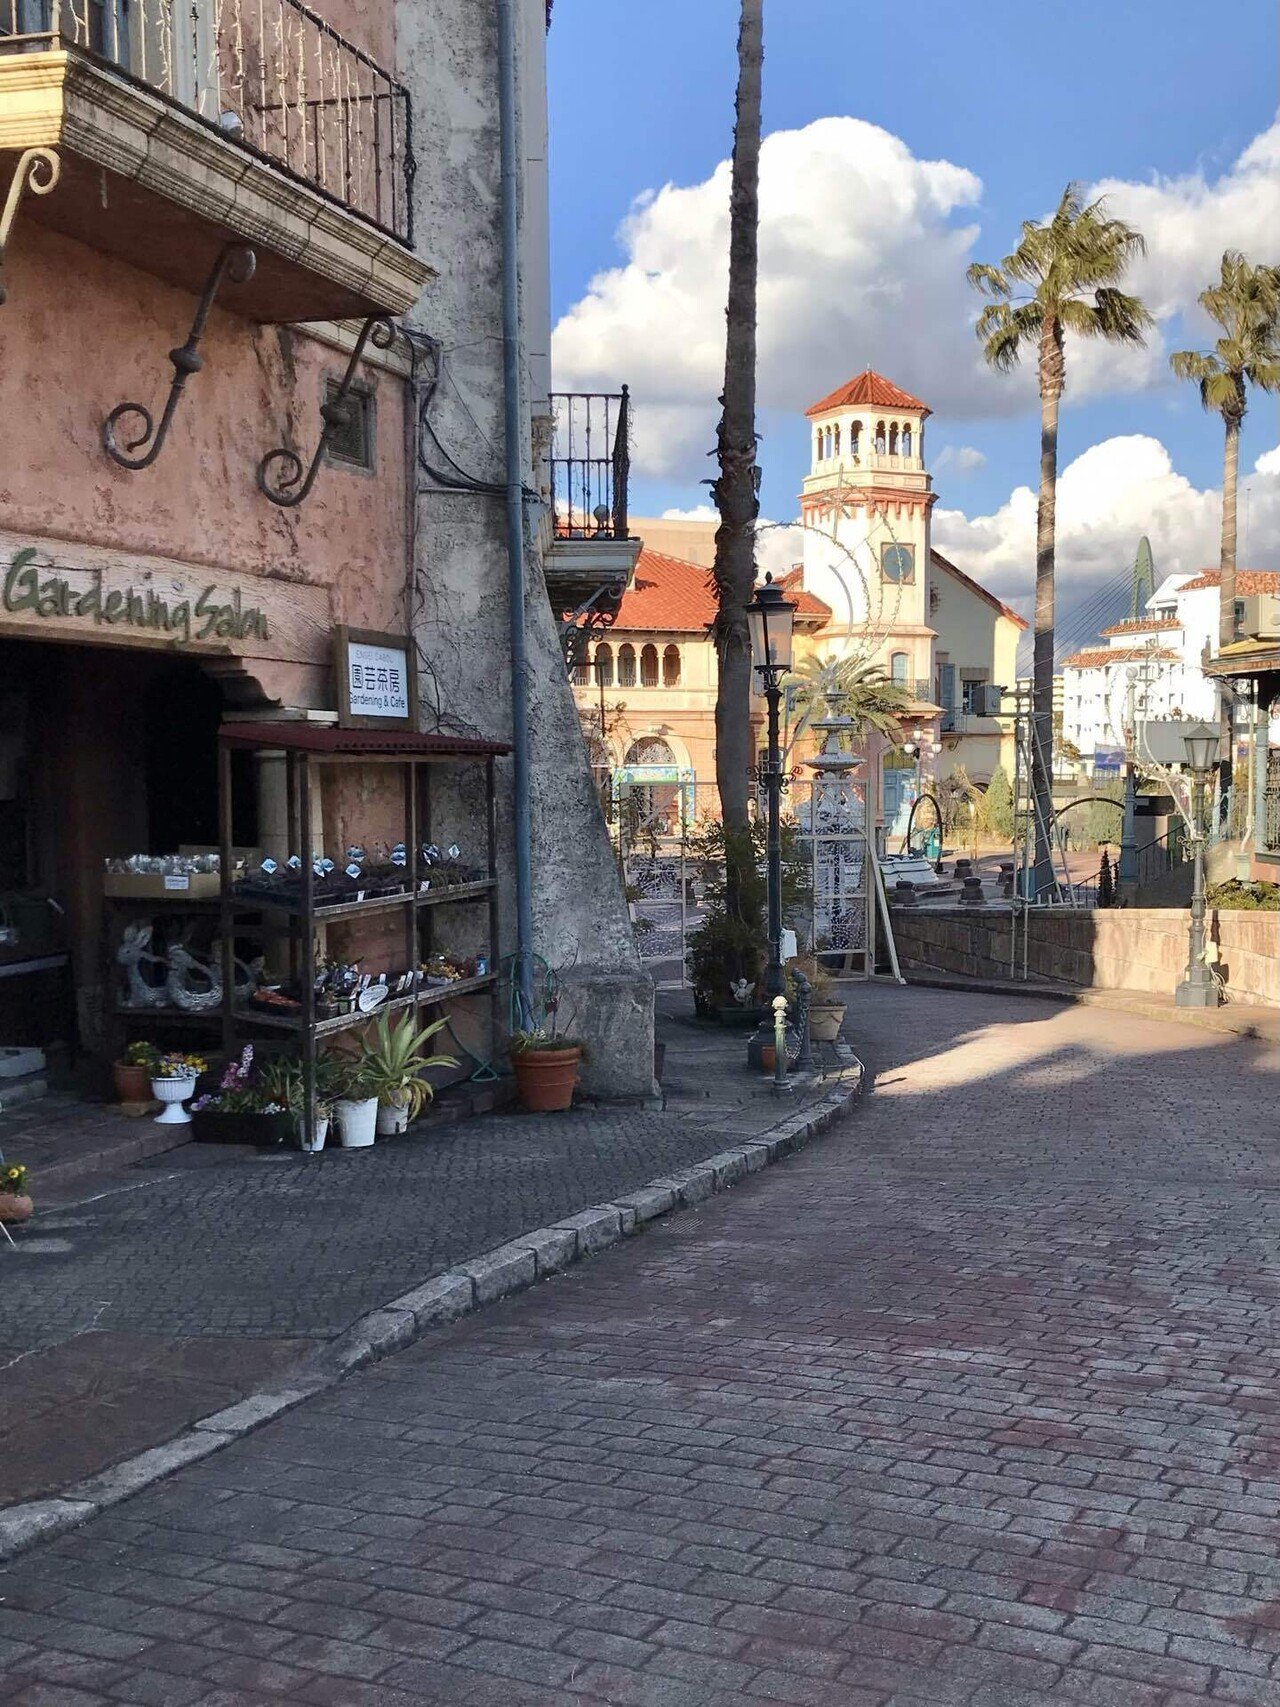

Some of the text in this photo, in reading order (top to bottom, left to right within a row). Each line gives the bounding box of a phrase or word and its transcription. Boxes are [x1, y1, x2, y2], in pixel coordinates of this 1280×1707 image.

[4, 548, 190, 647] Gardening
[352, 664, 400, 693] 園芸茶房
[384, 695, 389, 707] &
